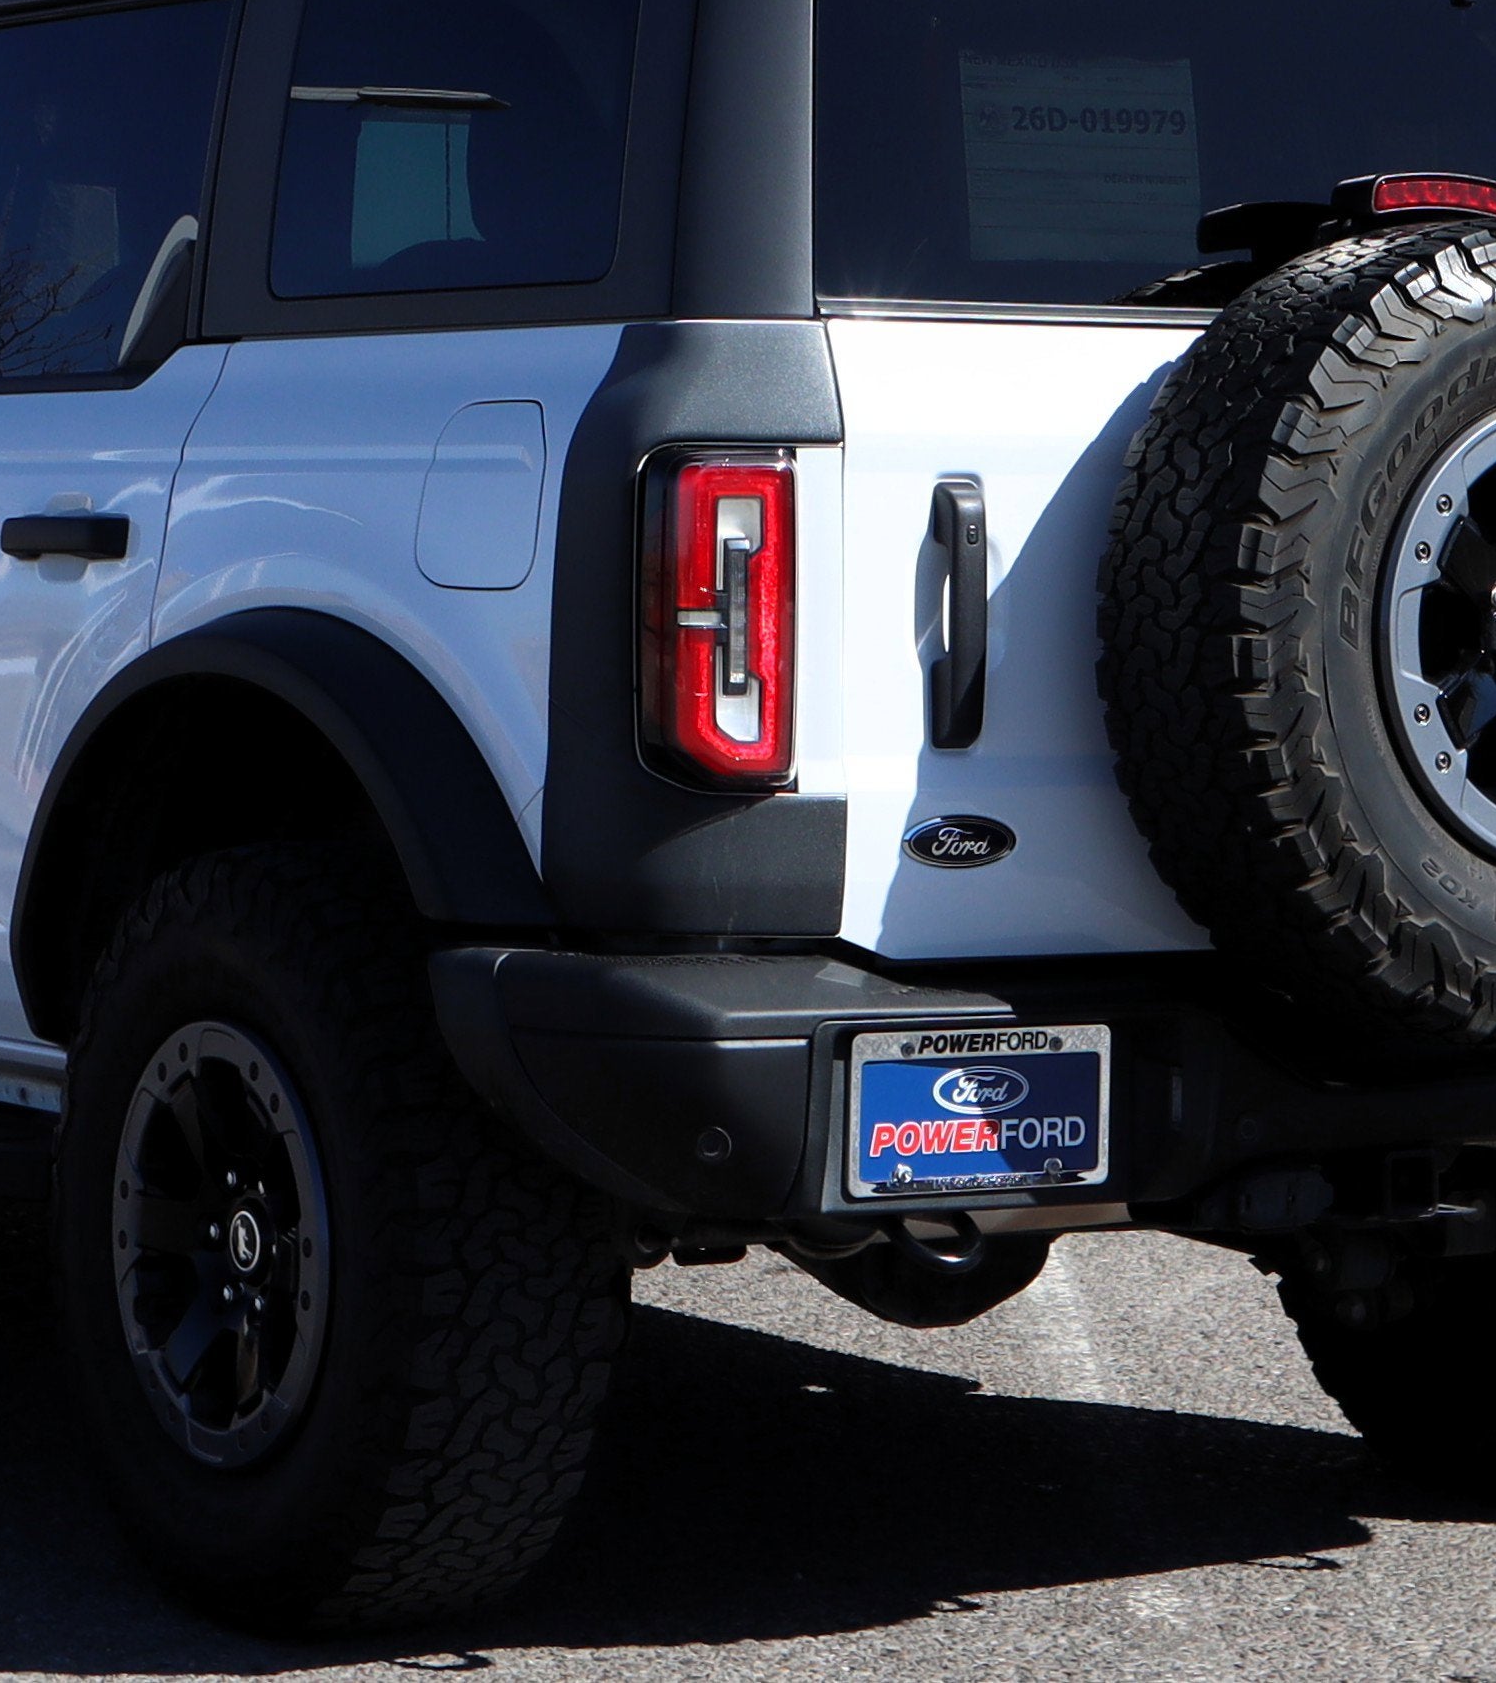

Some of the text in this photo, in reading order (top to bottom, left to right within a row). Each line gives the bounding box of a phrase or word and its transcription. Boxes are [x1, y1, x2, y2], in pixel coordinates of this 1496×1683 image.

[1011, 105, 1186, 135] 26D-019979
[931, 826, 991, 856] Ford
[917, 1031, 1049, 1055] POWERFORD
[952, 1074, 1009, 1104] Ford
[869, 1116, 1087, 1158] POWERFORD
